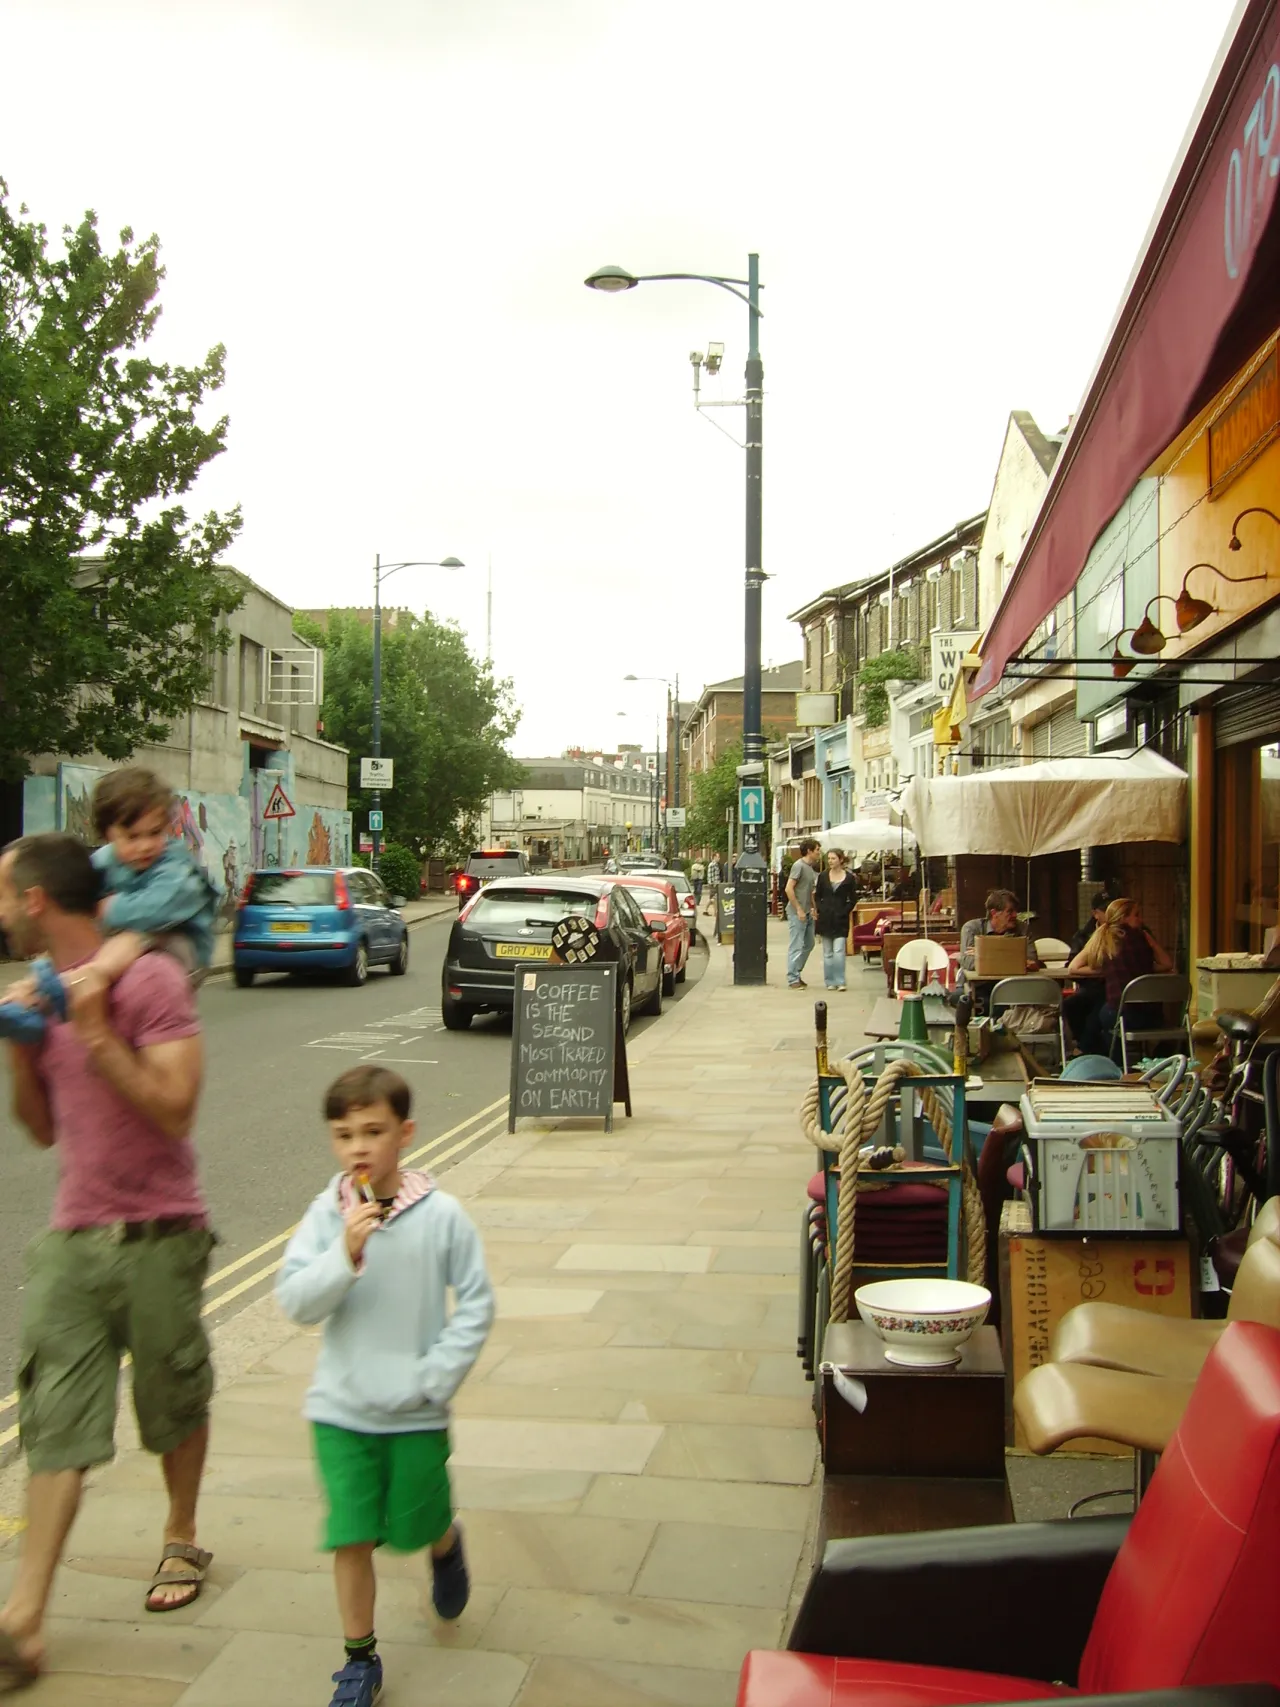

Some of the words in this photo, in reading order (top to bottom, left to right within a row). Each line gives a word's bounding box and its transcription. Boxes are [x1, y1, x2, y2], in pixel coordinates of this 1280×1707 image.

[940, 639, 953, 647] THE
[501, 945, 527, 956] GR07
[529, 946, 550, 957] JVK
[536, 984, 602, 1001] COFFEE
[526, 1003, 541, 1019] IS
[544, 1002, 575, 1022] THE
[532, 1023, 595, 1041] SECOND
[521, 1090, 542, 1108] ON
[550, 1089, 600, 1109] EARTH
[1052, 1153, 1078, 1162] MORE
[1137, 1150, 1167, 1218] BASEMENT
[1024, 1247, 1050, 1369] PEACOCK
